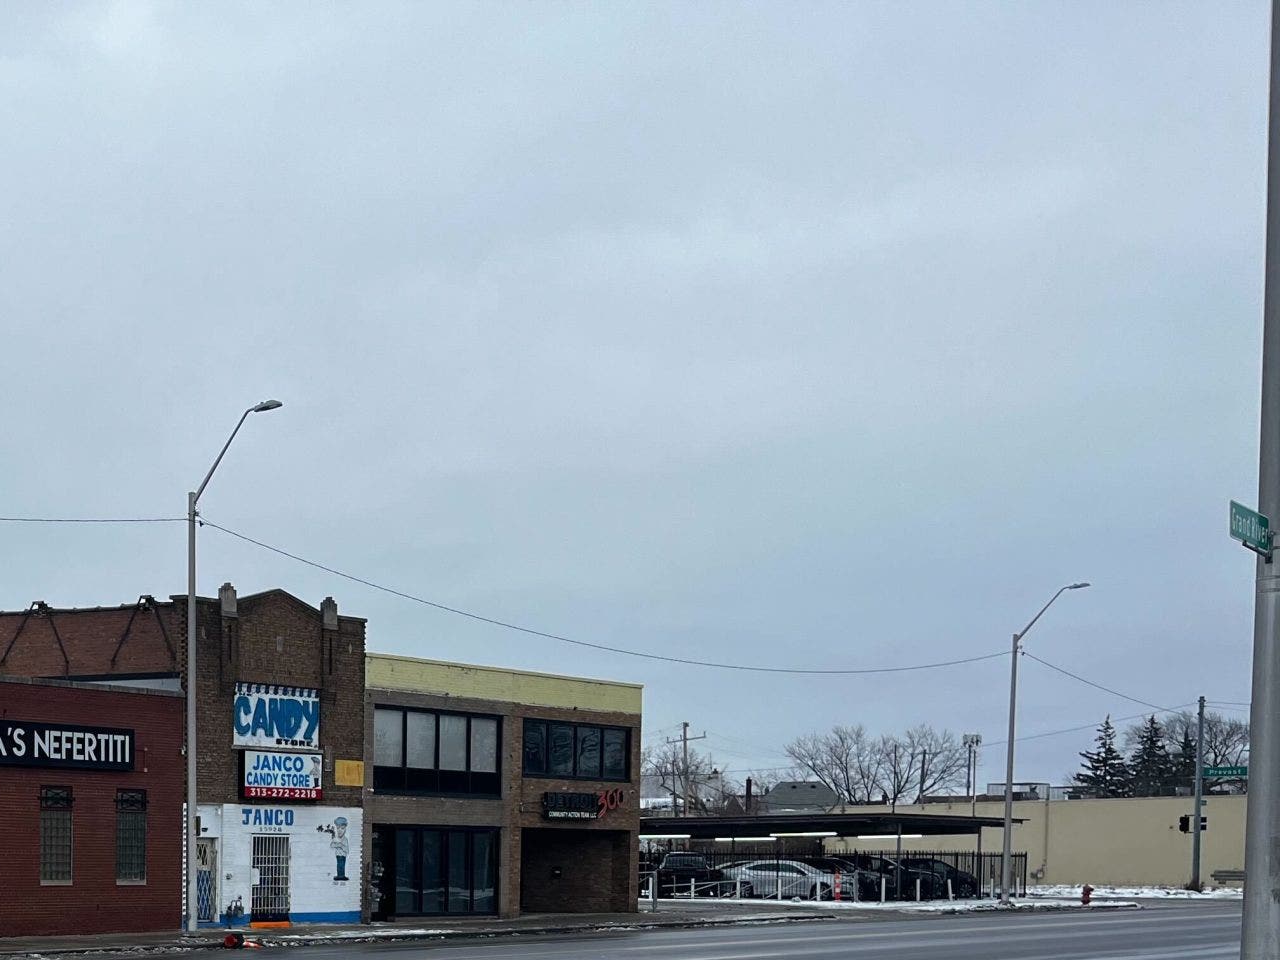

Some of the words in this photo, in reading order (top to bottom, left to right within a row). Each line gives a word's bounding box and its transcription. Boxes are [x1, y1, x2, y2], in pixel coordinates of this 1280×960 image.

[1232, 508, 1250, 537] Grand
[1252, 517, 1268, 543] River
[234, 695, 319, 741] CANDY
[34, 729, 130, 763] NEFERTITI
[253, 755, 304, 772] JANCO
[246, 772, 279, 786] CANDY
[280, 773, 310, 787] STORE
[250, 788, 317, 798] 313-272-2218
[598, 787, 624, 818] 300
[241, 808, 294, 826] JANCO
